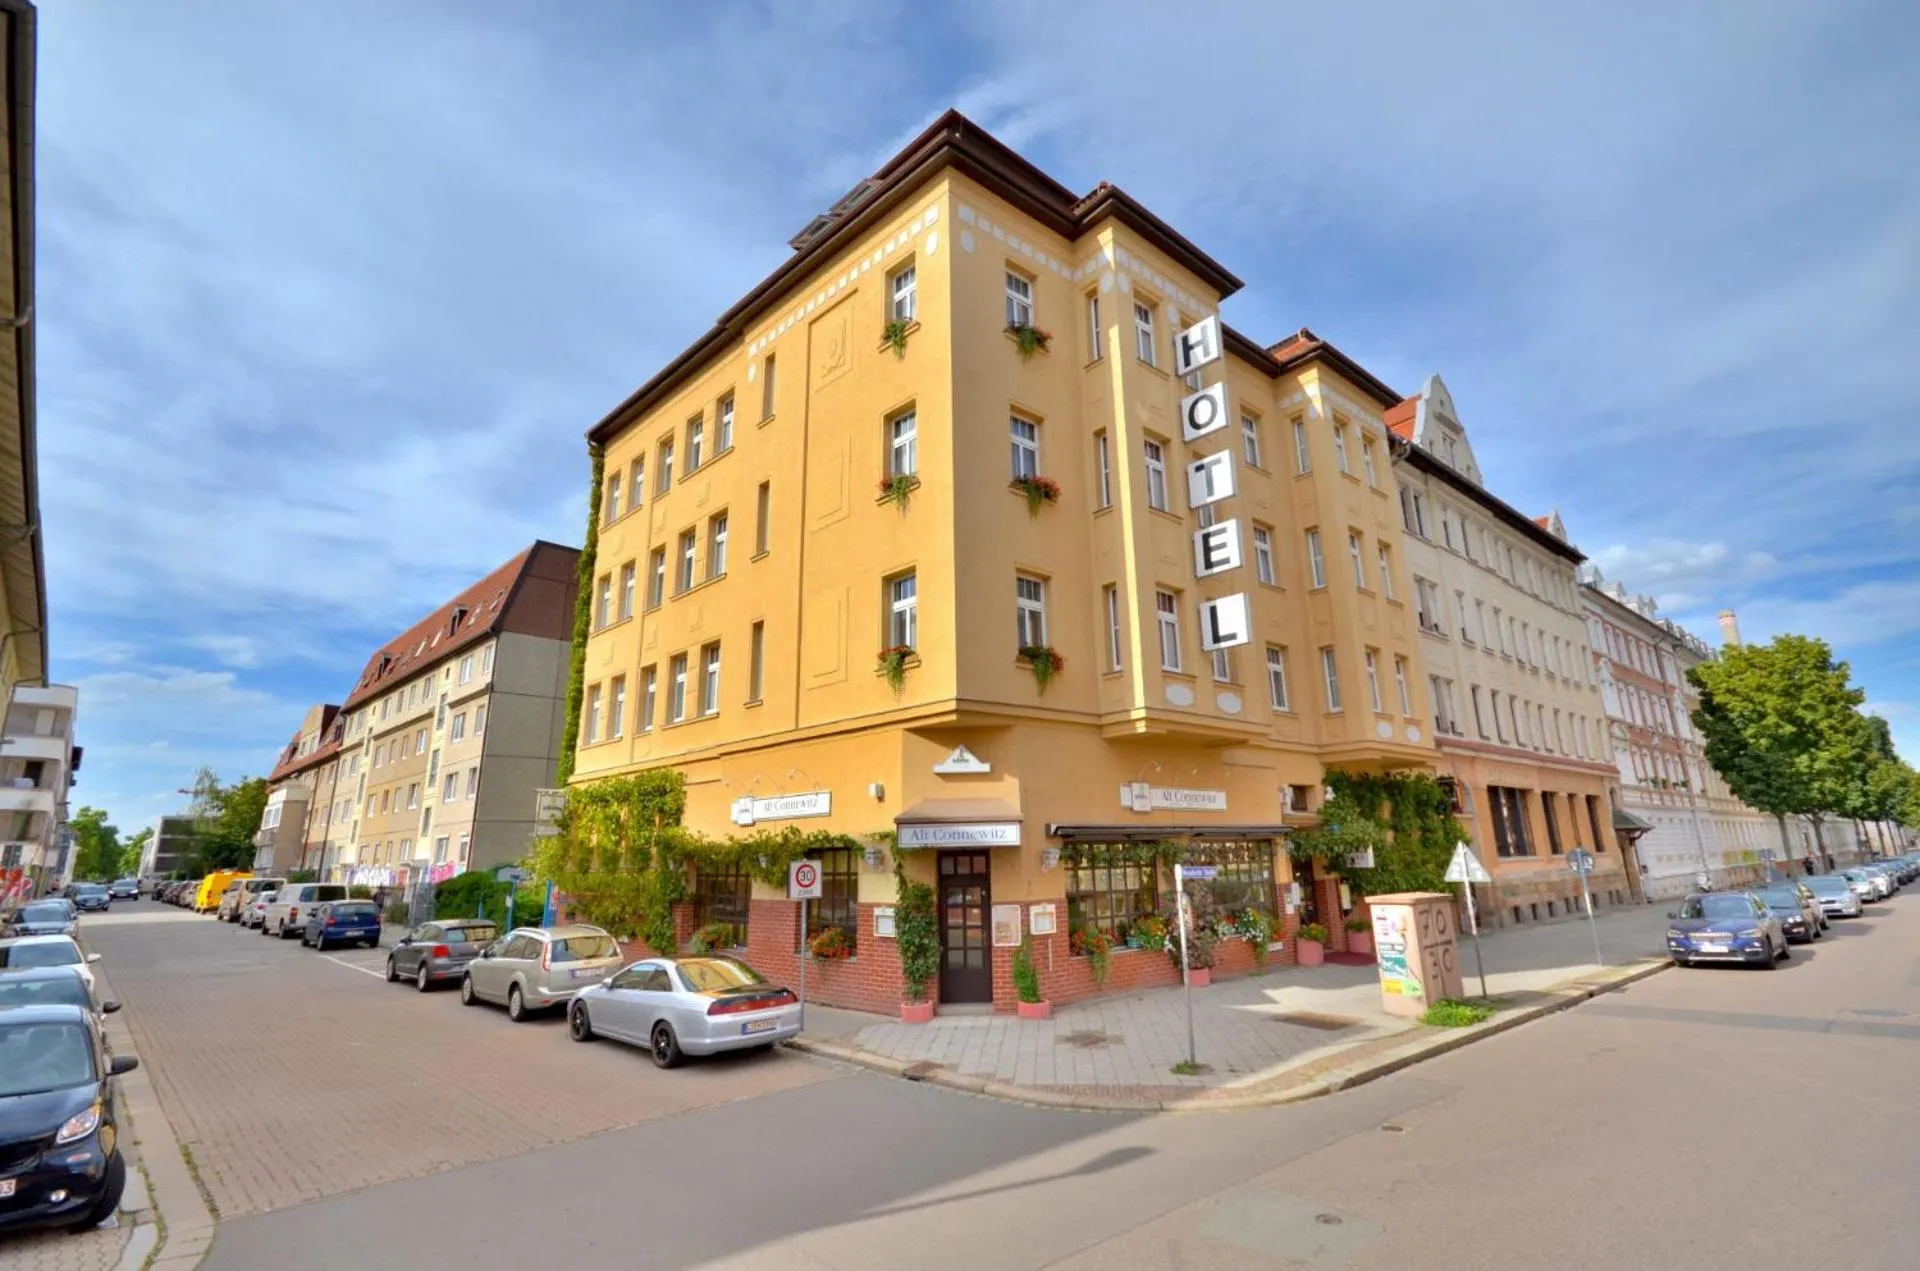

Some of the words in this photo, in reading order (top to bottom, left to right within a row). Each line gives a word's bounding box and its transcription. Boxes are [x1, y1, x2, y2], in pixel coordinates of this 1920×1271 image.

[1180, 322, 1238, 646] HOTEL
[911, 828, 928, 841] Alt
[932, 827, 1008, 841] Connewitz
[800, 870, 814, 882] 30
